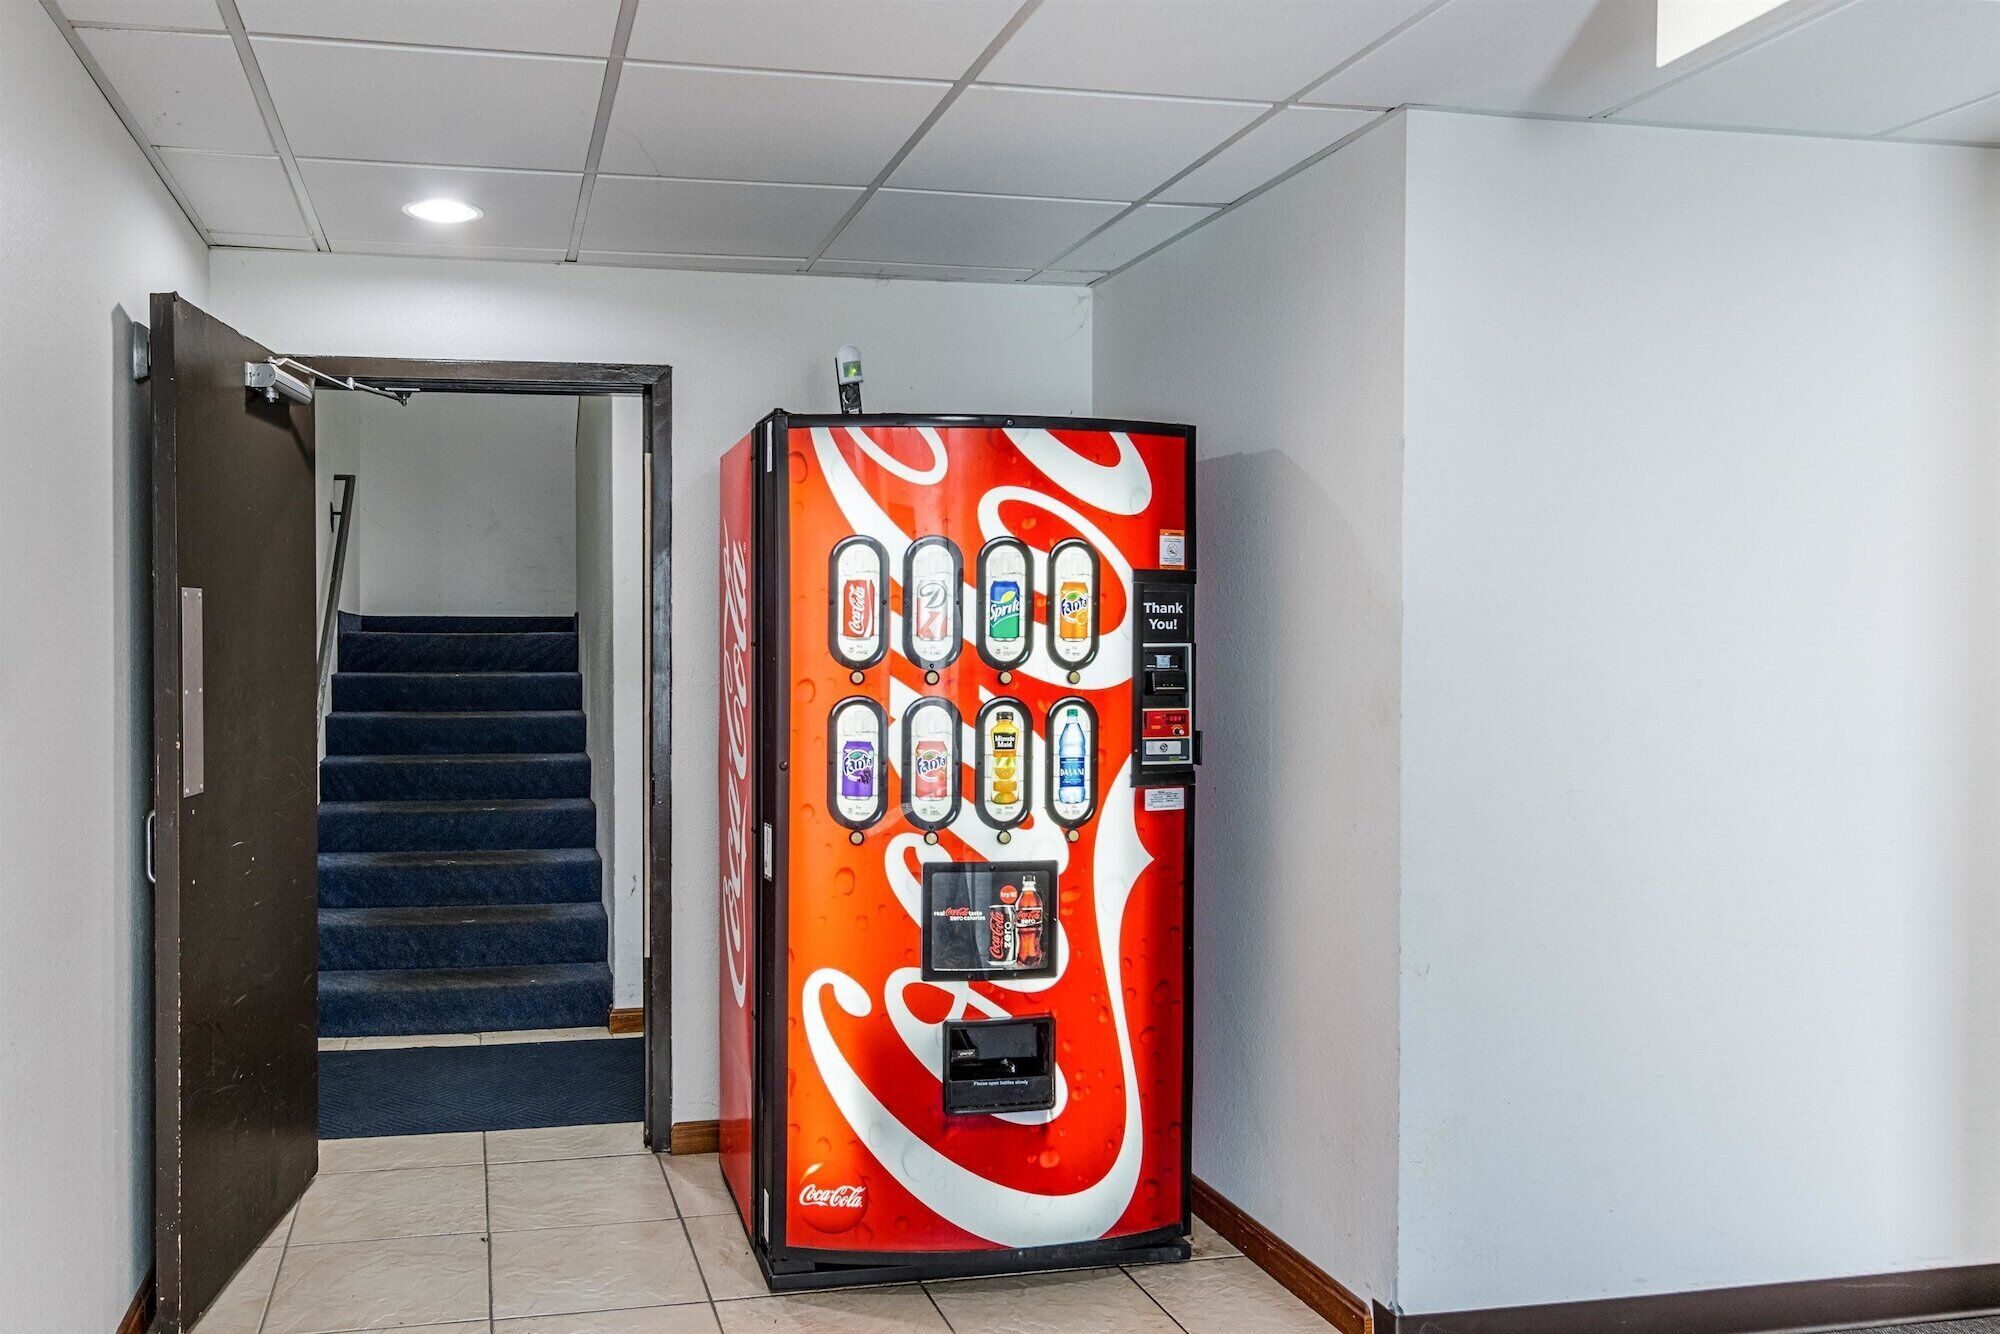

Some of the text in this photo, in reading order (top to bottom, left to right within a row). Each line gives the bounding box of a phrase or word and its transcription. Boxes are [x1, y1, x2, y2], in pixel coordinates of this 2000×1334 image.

[1143, 602, 1184, 614] Thank
[1148, 618, 1178, 630] You!
[1004, 922, 1012, 949] zero
